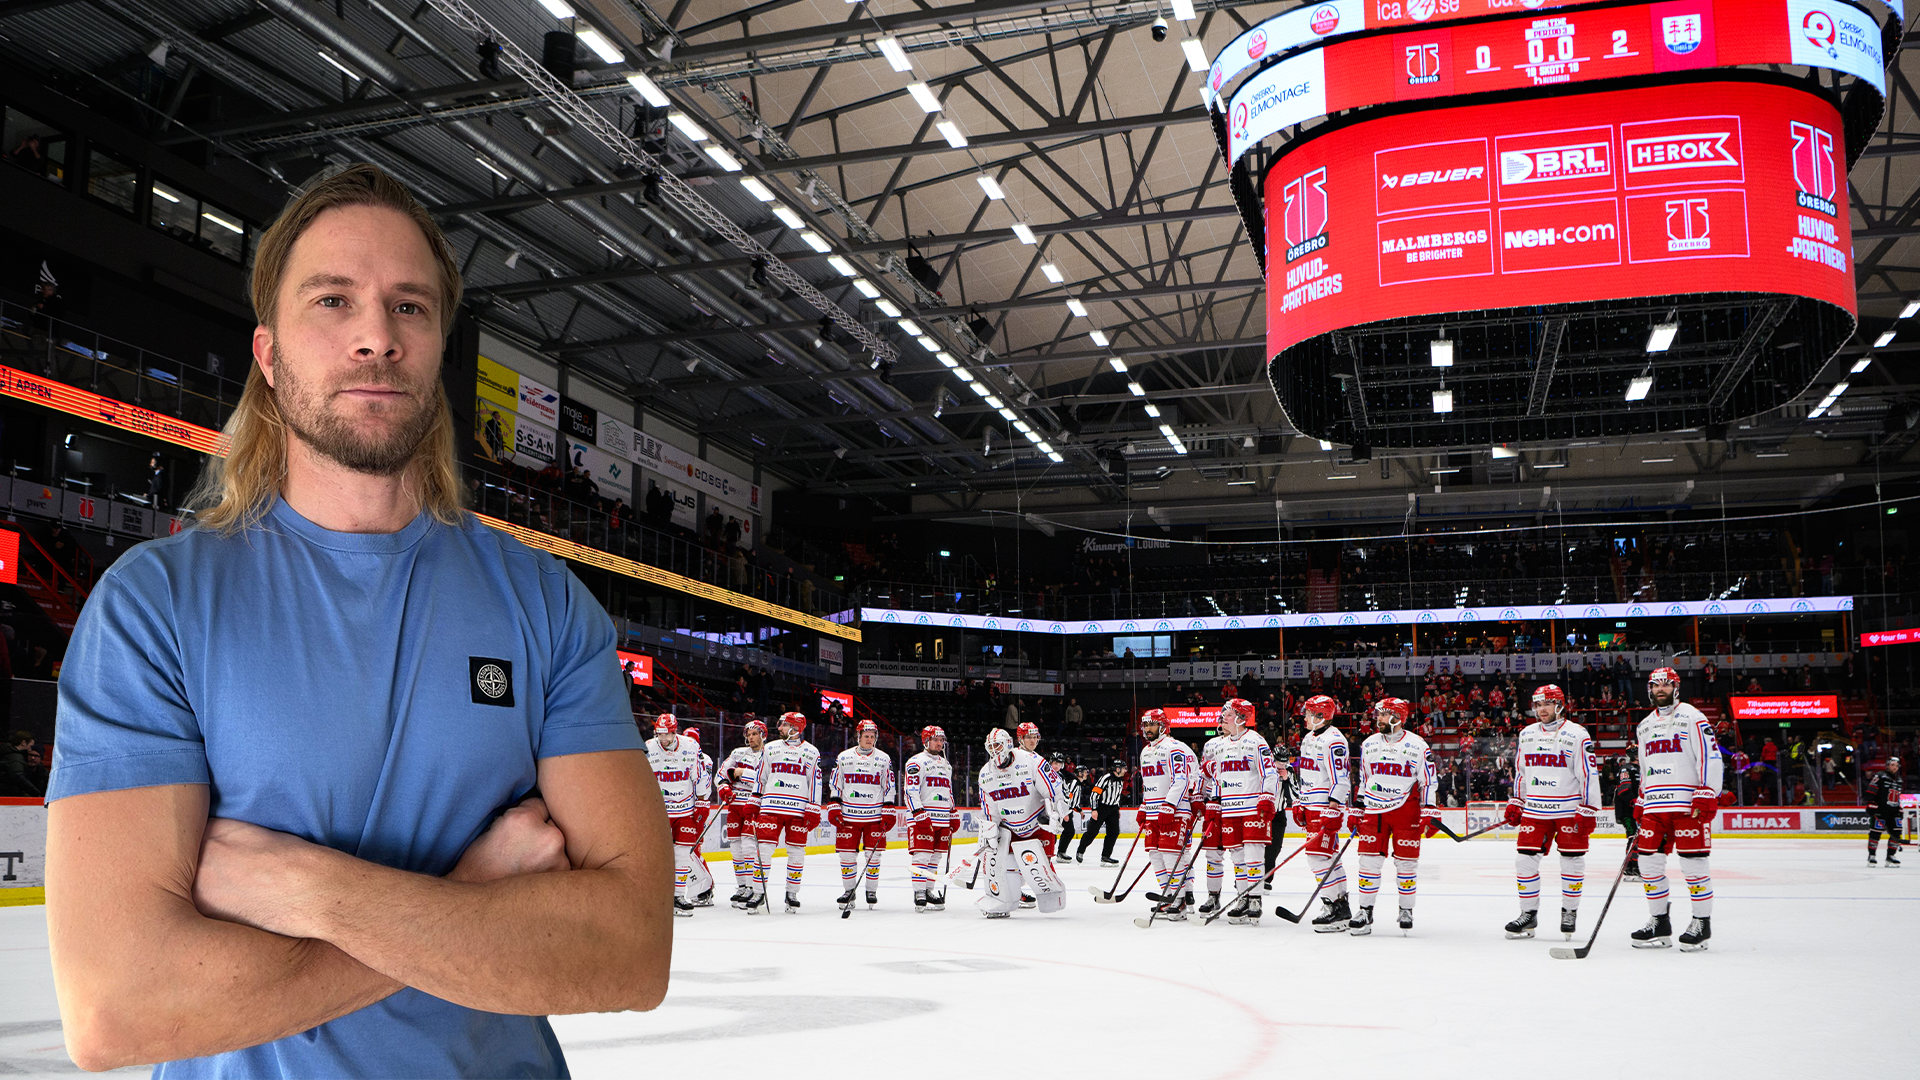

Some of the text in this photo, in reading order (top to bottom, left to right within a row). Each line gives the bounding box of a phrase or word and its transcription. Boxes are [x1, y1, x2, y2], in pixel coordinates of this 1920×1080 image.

[1527, 36, 1573, 64] 0.0
[1612, 29, 1628, 55] 2
[1475, 45, 1491, 70] 0
[1250, 81, 1311, 120] ELMONTAGE
[1536, 148, 1606, 173] BRL
[1637, 141, 1715, 165] HEROK
[1400, 166, 1484, 188] BAUER
[1798, 191, 1836, 216] ÖREBRO
[1798, 214, 1839, 245] HUVUD-
[1287, 235, 1326, 262] ÖREBRO
[1382, 229, 1488, 254] MALMBERGS
[1671, 240, 1708, 249] ÖREBRO
[1406, 247, 1463, 263] BE BRIGHTER
[1287, 257, 1328, 290] HUVUD-
[17, 379, 52, 399] APPEN
[520, 392, 557, 416] Weidermans
[564, 405, 583, 421] make
[573, 420, 594, 438] brand
[634, 431, 663, 463] FLEX
[1137, 540, 1171, 550] LOUNGE
[916, 678, 950, 691] DET ÄR VI
[1370, 760, 1413, 778] TMRÅ
[1524, 750, 1567, 768] TIMRÅ
[844, 772, 881, 785] TIMRÅ
[907, 775, 920, 785] 63
[926, 776, 951, 788] TIMR
[1244, 820, 1265, 829] coop
[1731, 814, 1791, 829] NEMAX
[1397, 839, 1419, 848] coop
